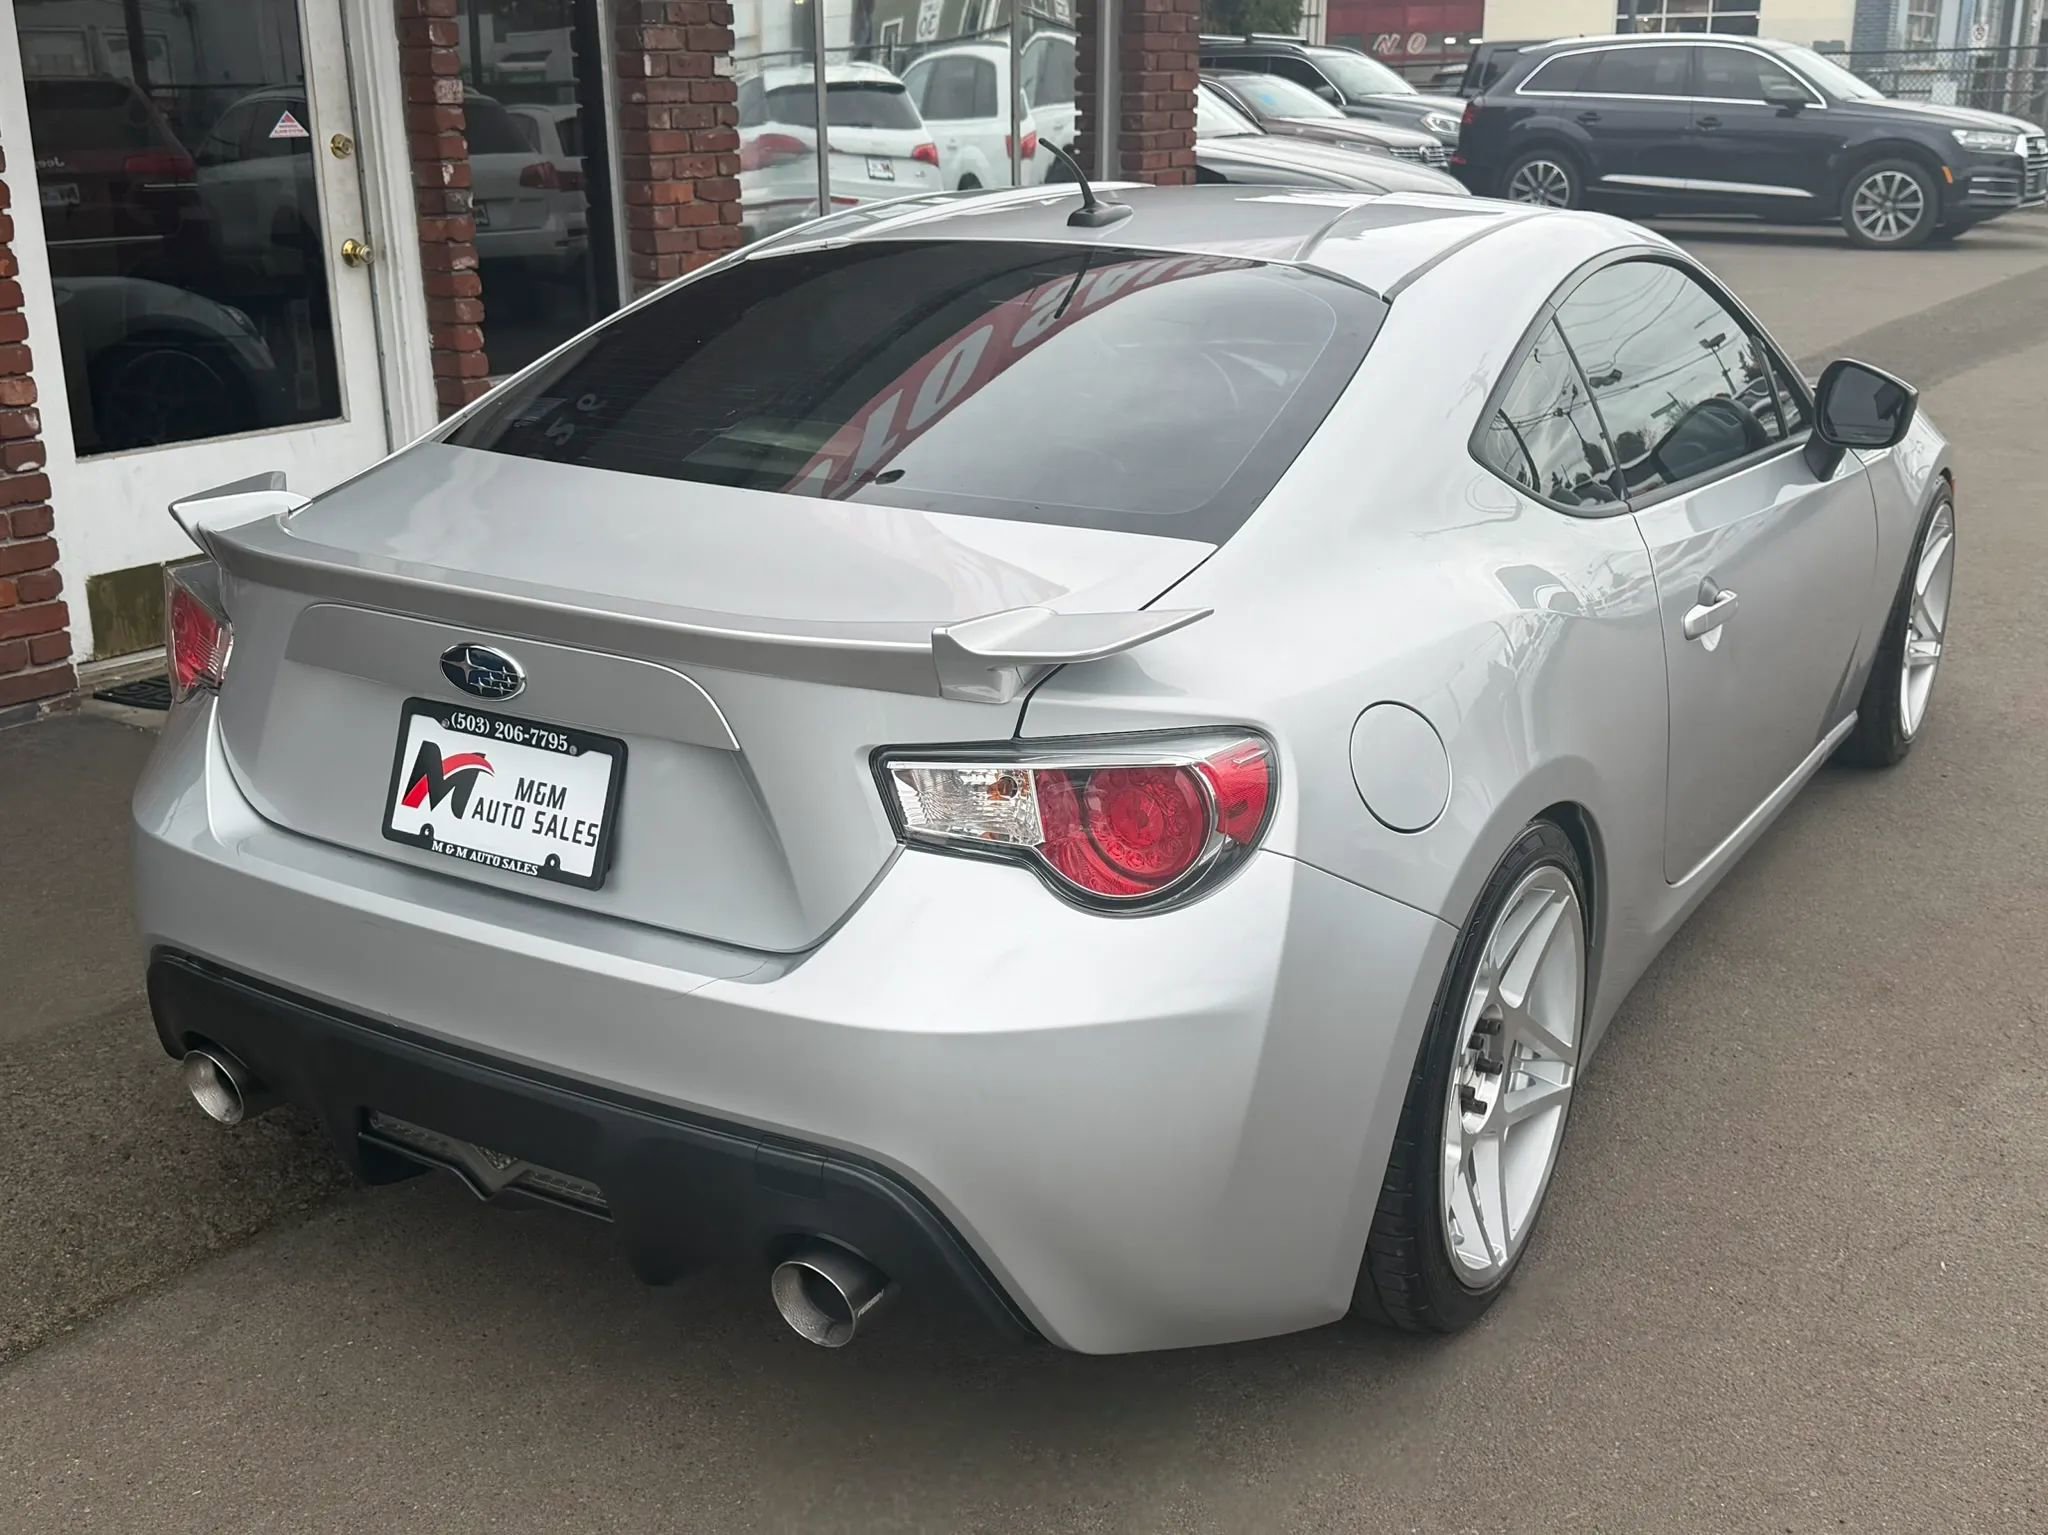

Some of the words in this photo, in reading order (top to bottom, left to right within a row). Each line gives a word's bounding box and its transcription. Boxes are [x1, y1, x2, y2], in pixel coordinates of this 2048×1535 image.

[451, 712, 491, 735] (503)
[495, 722, 568, 751] 206-7795
[514, 777, 567, 810] M&M
[471, 797, 525, 830] AUTO
[532, 811, 599, 847] SALES
[431, 841, 443, 852] M
[445, 844, 455, 854] &
[456, 847, 469, 859] M
[469, 851, 501, 867] AUTO
[501, 859, 539, 876] SALES
